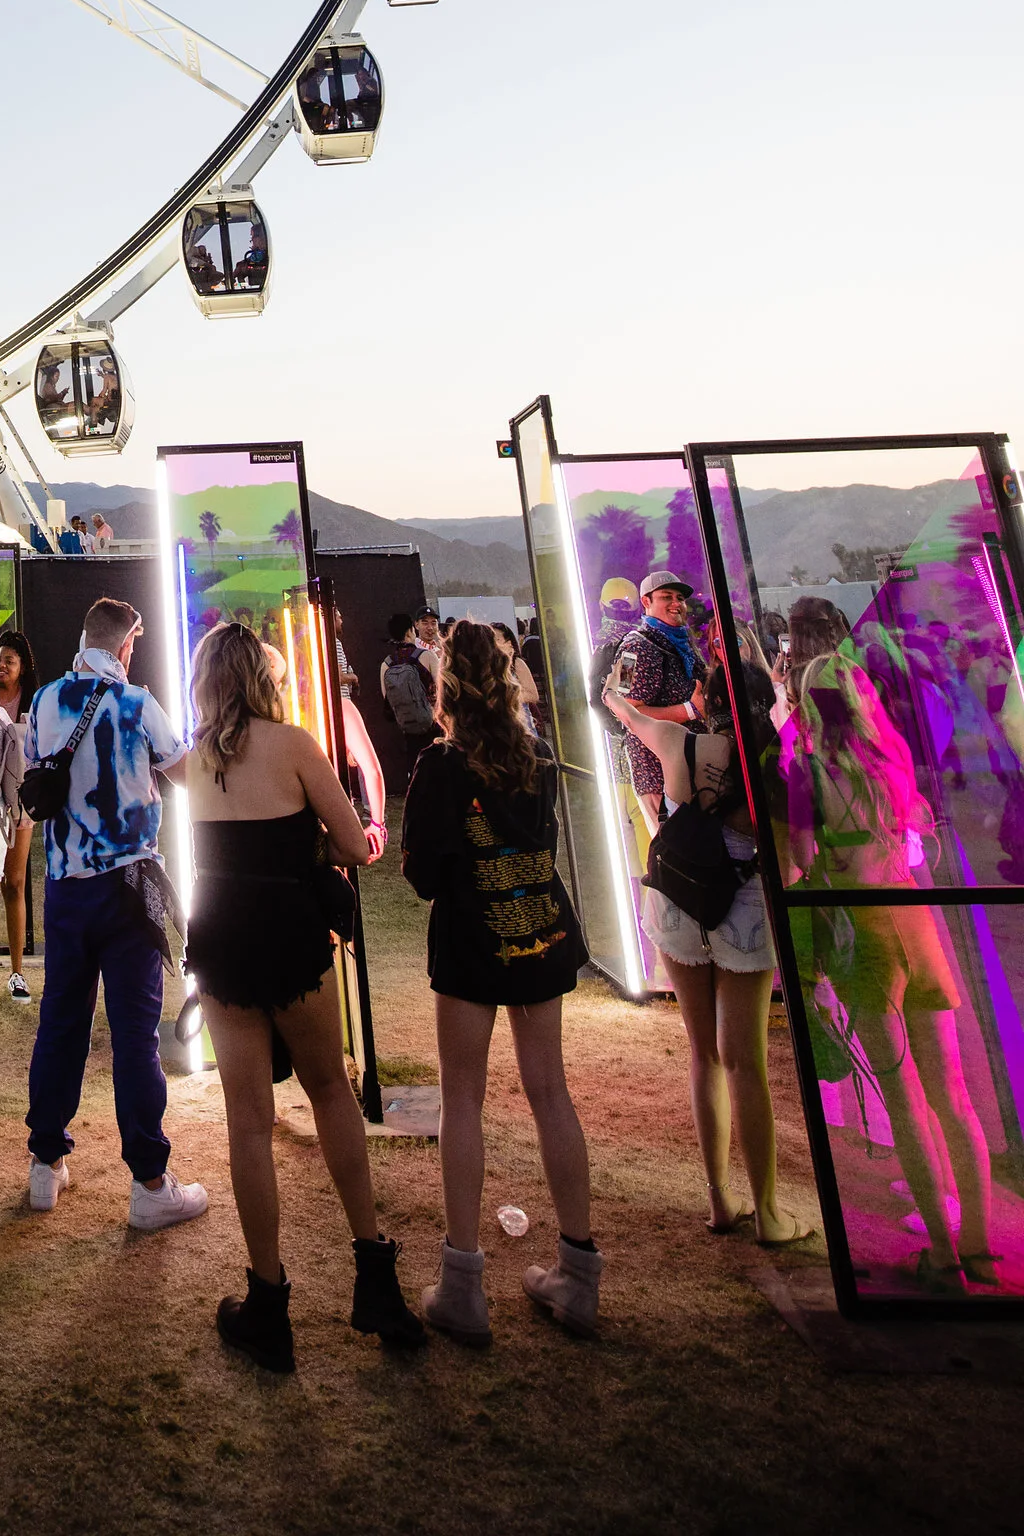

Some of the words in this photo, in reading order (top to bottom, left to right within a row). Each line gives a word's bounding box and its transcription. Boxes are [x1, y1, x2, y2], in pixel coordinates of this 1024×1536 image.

[499, 442, 513, 456] G
[252, 452, 292, 463] #teampixel
[1002, 474, 1018, 500] G
